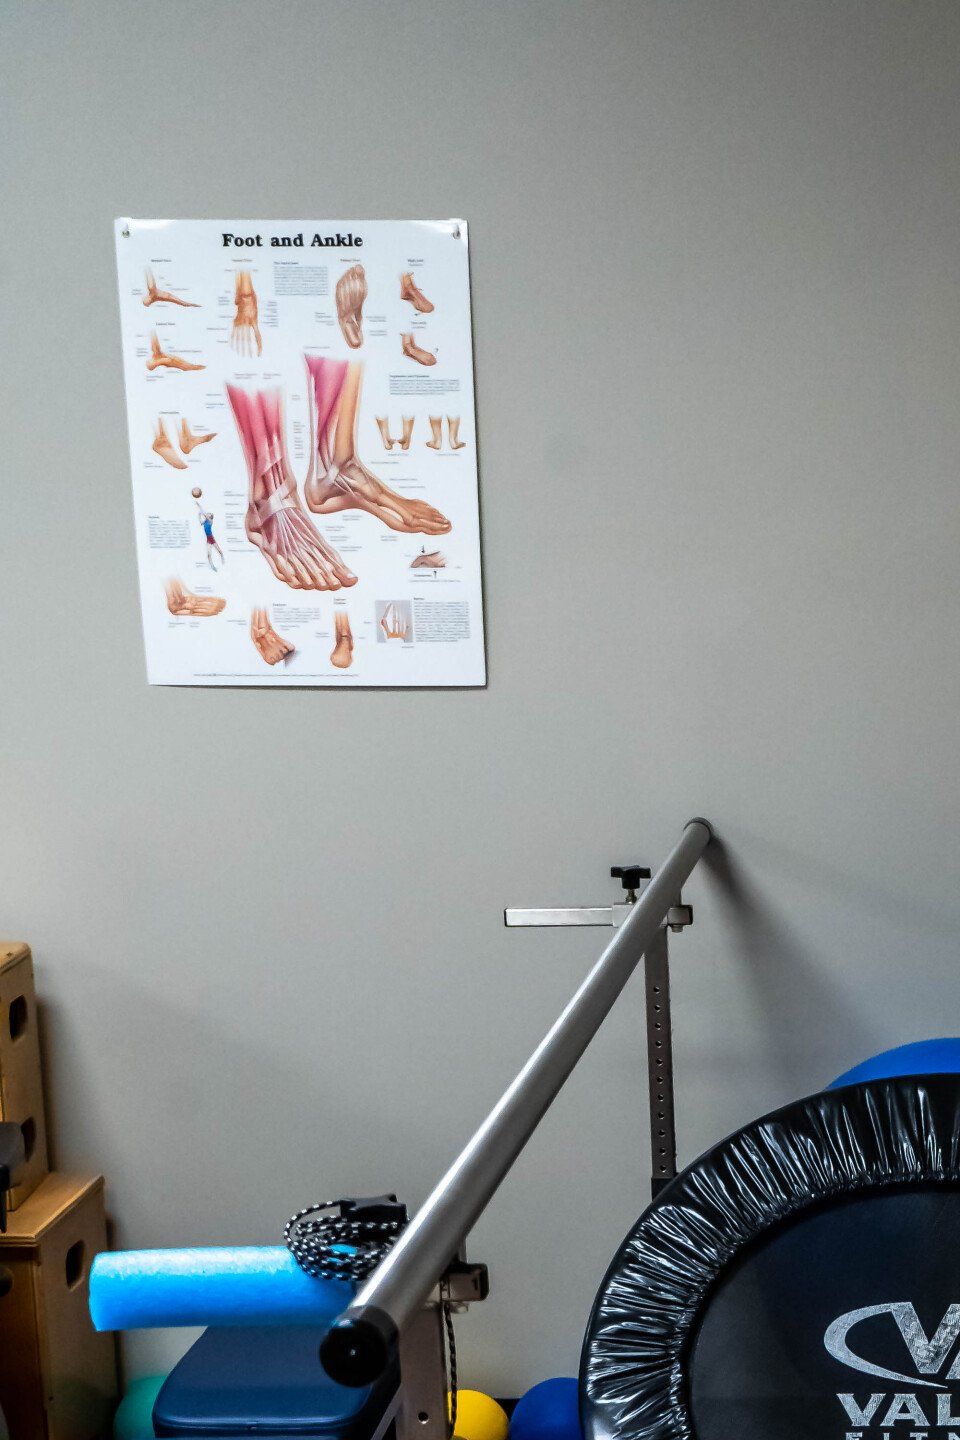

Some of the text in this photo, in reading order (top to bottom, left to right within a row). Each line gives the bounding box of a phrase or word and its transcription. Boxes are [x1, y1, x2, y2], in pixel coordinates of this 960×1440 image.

[222, 233, 364, 247] Foot and Ankle
